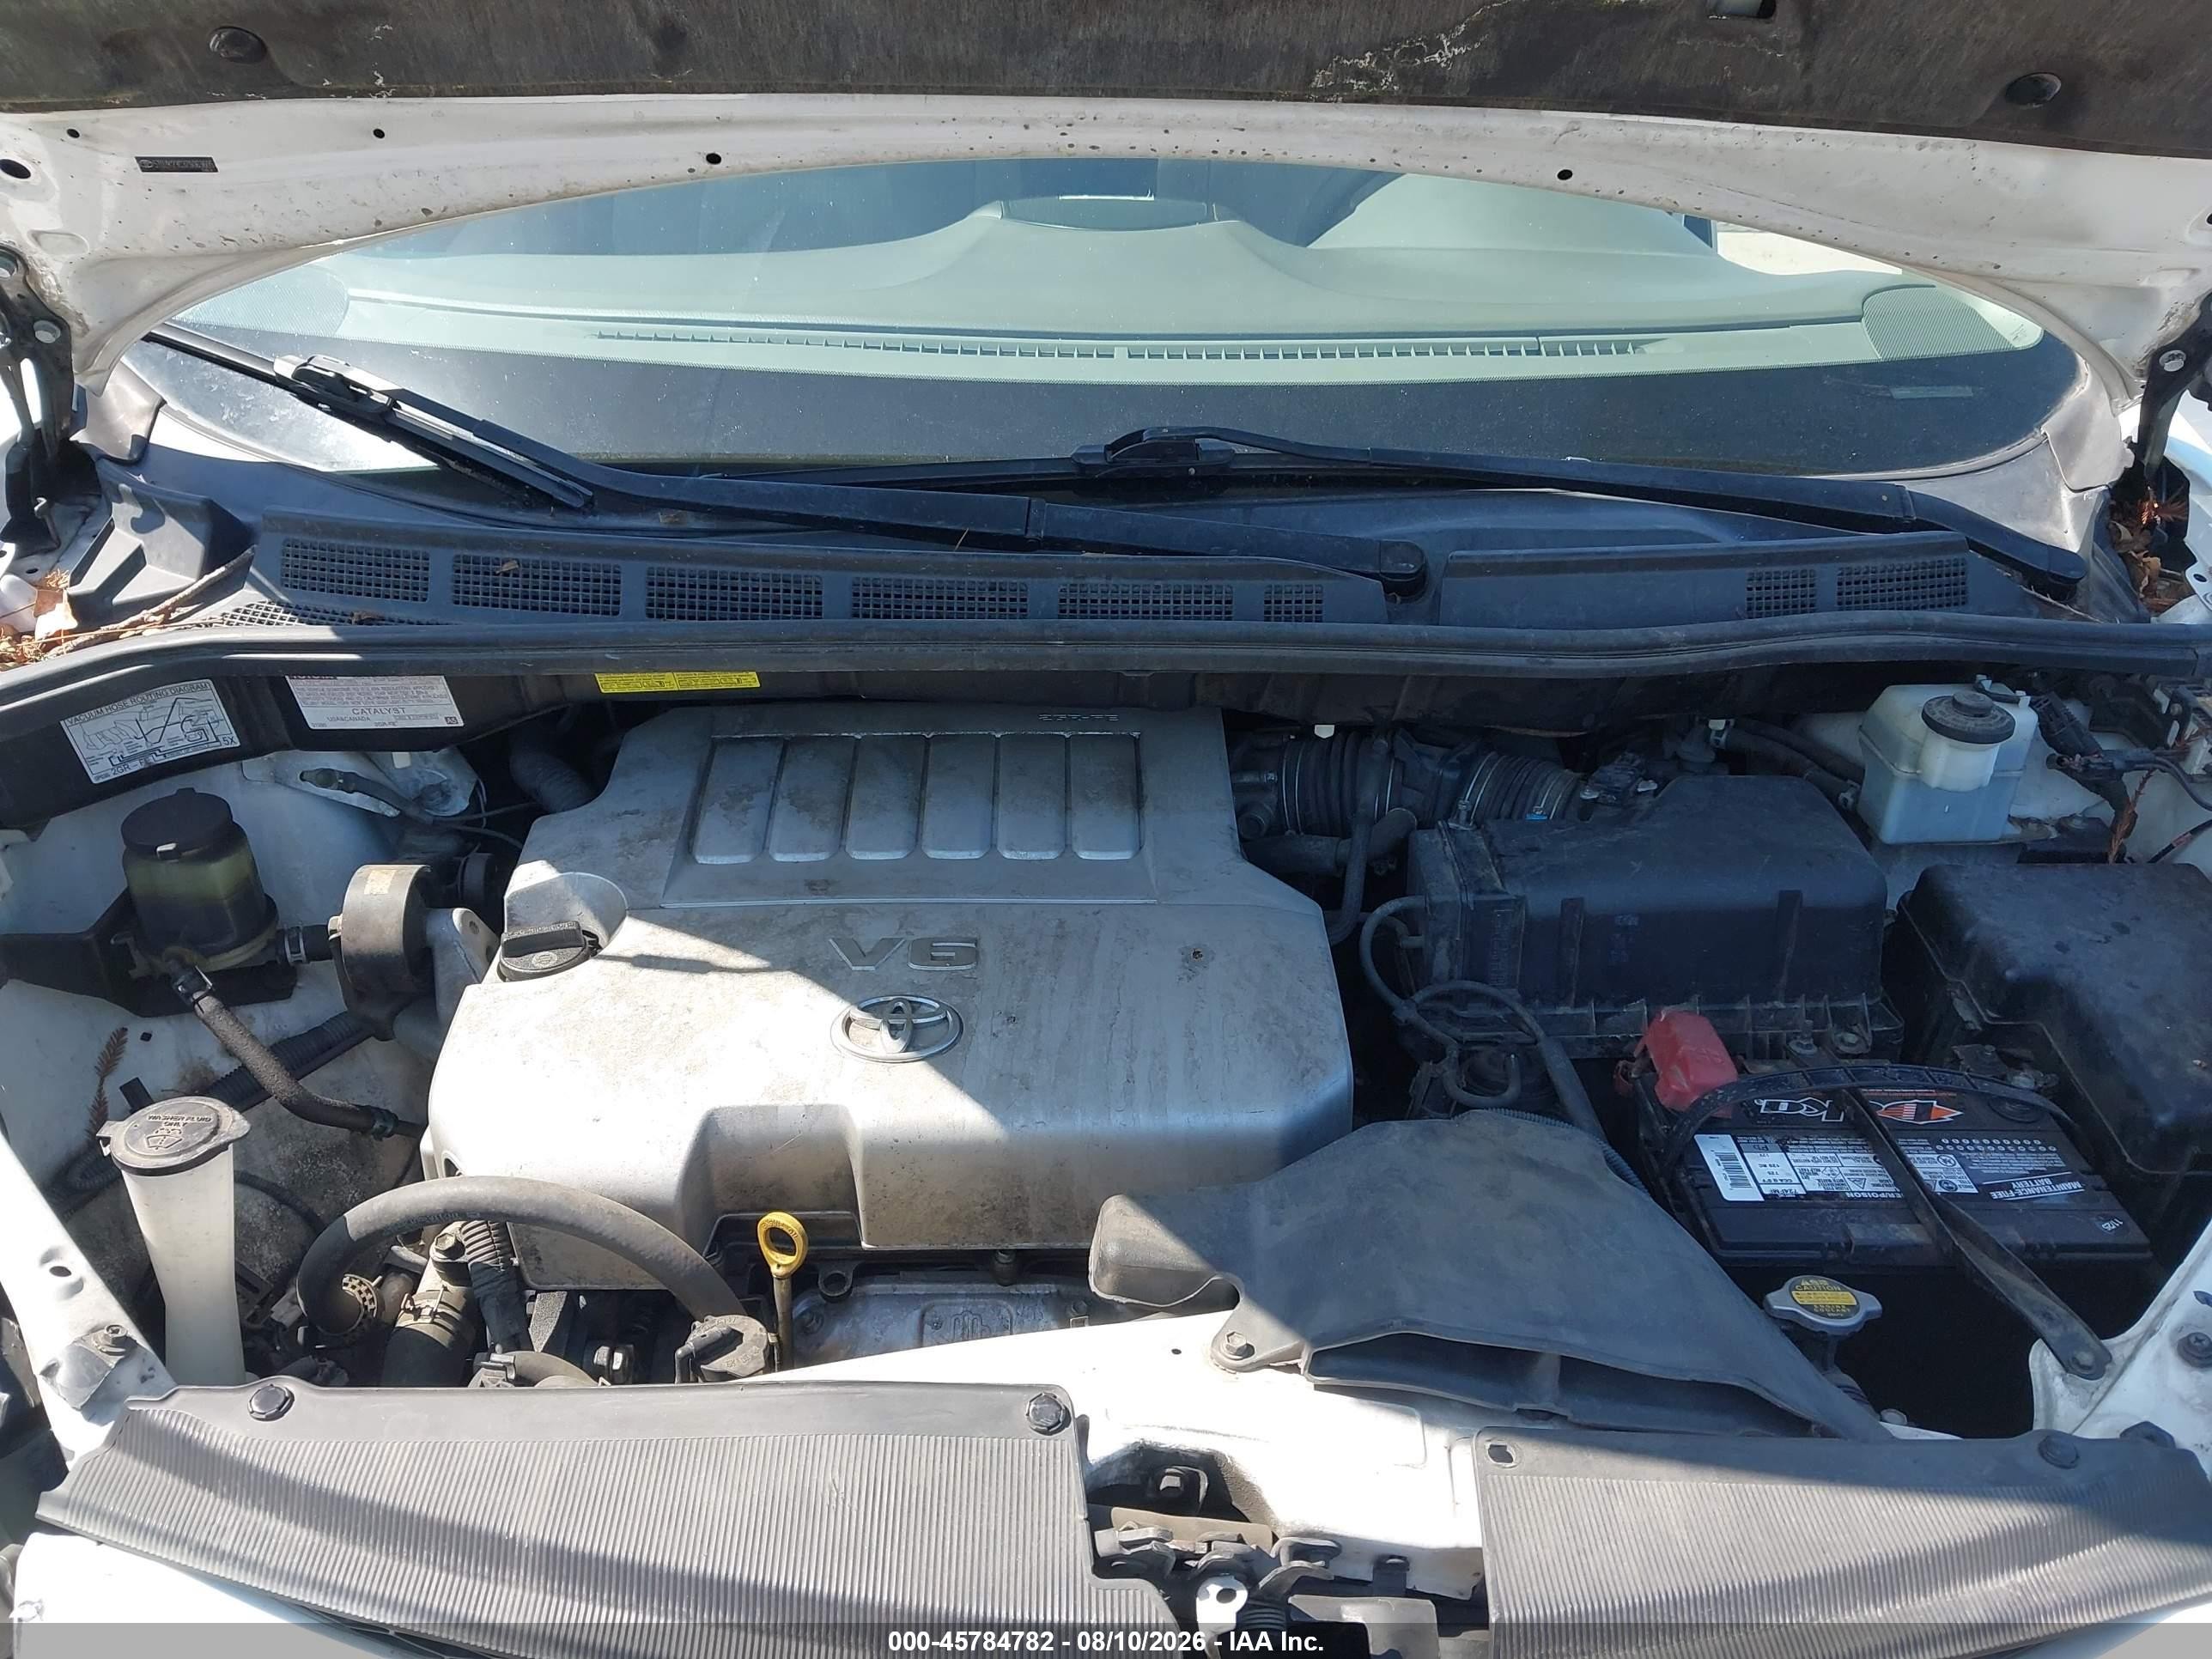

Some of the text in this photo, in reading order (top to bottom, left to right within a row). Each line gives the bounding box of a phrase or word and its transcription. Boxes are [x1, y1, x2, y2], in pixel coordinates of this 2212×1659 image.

[68, 682, 209, 726] VACUUM HOSE ROUTING DIAGRAM
[222, 735, 237, 745] 5X
[829, 937, 978, 970] V6
[1989, 1181, 2083, 1200] MAINTENANCE-FREE
[2011, 1179, 2053, 1190] BATTERY
